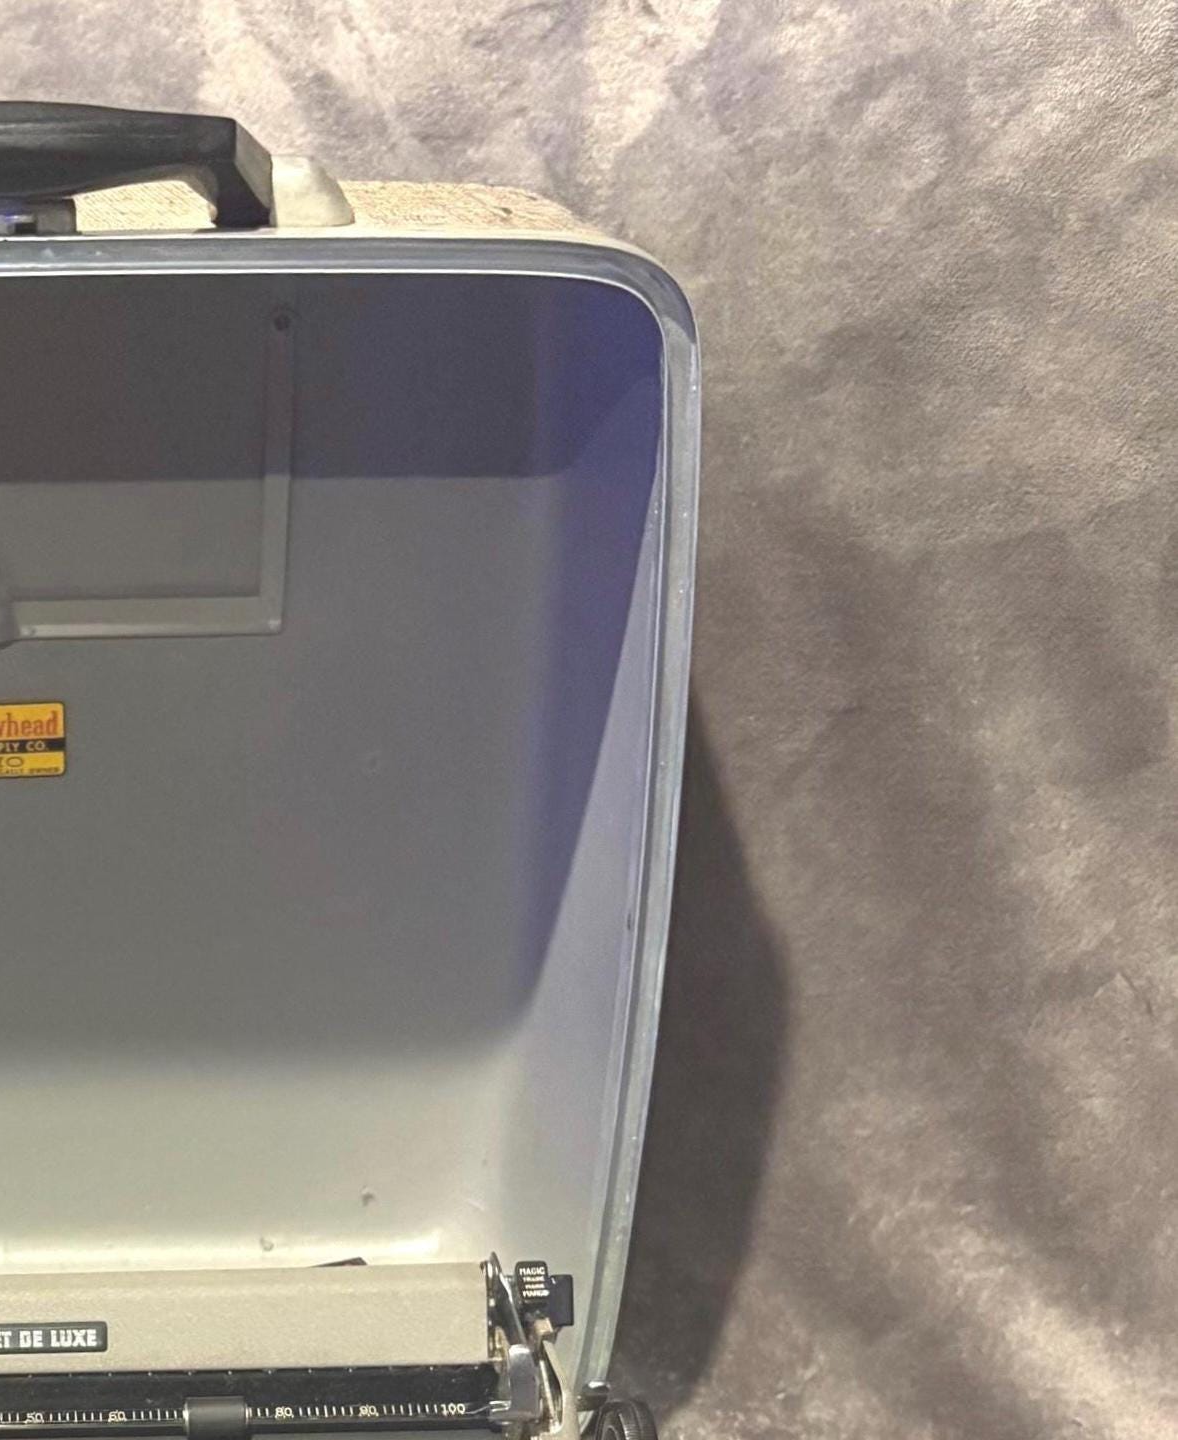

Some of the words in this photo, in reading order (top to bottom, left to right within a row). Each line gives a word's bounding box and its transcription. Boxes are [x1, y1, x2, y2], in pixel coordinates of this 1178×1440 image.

[26, 740, 49, 751] CO.
[519, 1267, 545, 1275] MAGIC
[20, 1331, 44, 1348] DE
[50, 1329, 97, 1347] LUXE
[26, 1412, 44, 1423] 50
[109, 1410, 127, 1421] 60
[275, 1406, 293, 1418] 80
[360, 1405, 377, 1416] 90
[440, 1403, 466, 1415] 100
